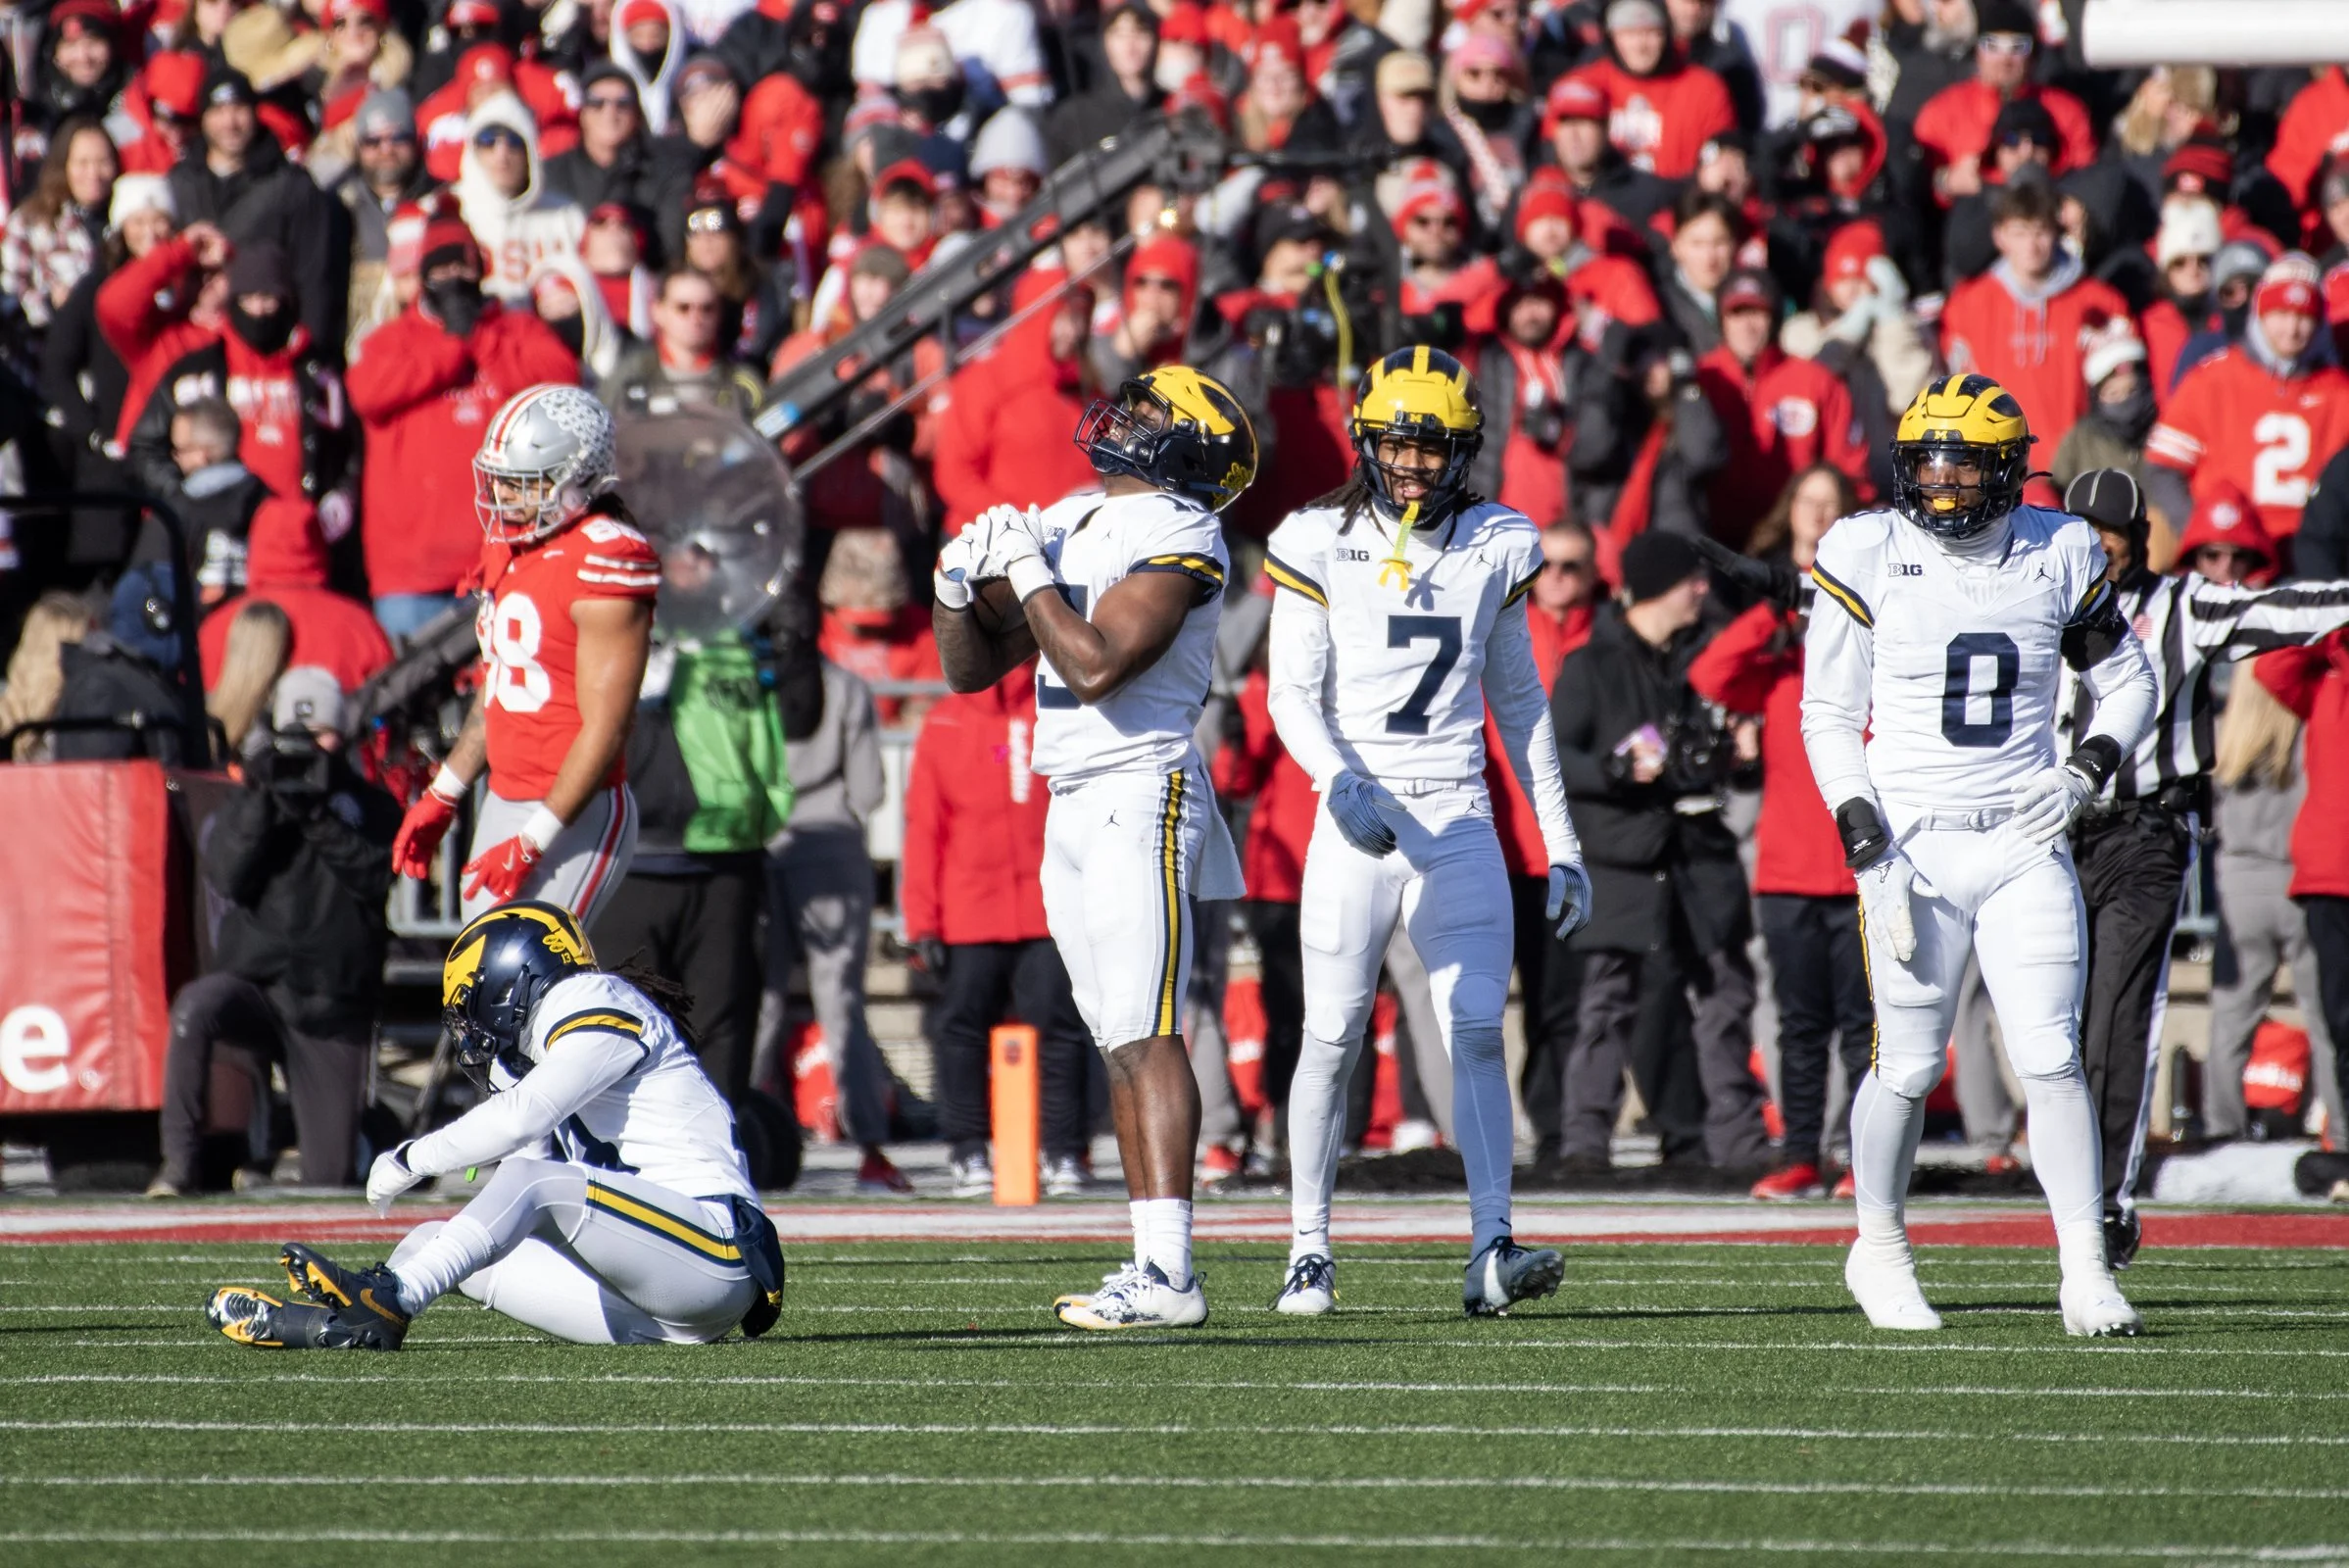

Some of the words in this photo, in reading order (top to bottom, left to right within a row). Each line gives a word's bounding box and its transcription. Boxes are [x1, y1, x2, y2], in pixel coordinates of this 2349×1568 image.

[2254, 413, 2311, 508] 2
[1385, 614, 1463, 736] 7
[1941, 632, 2020, 748] 0
